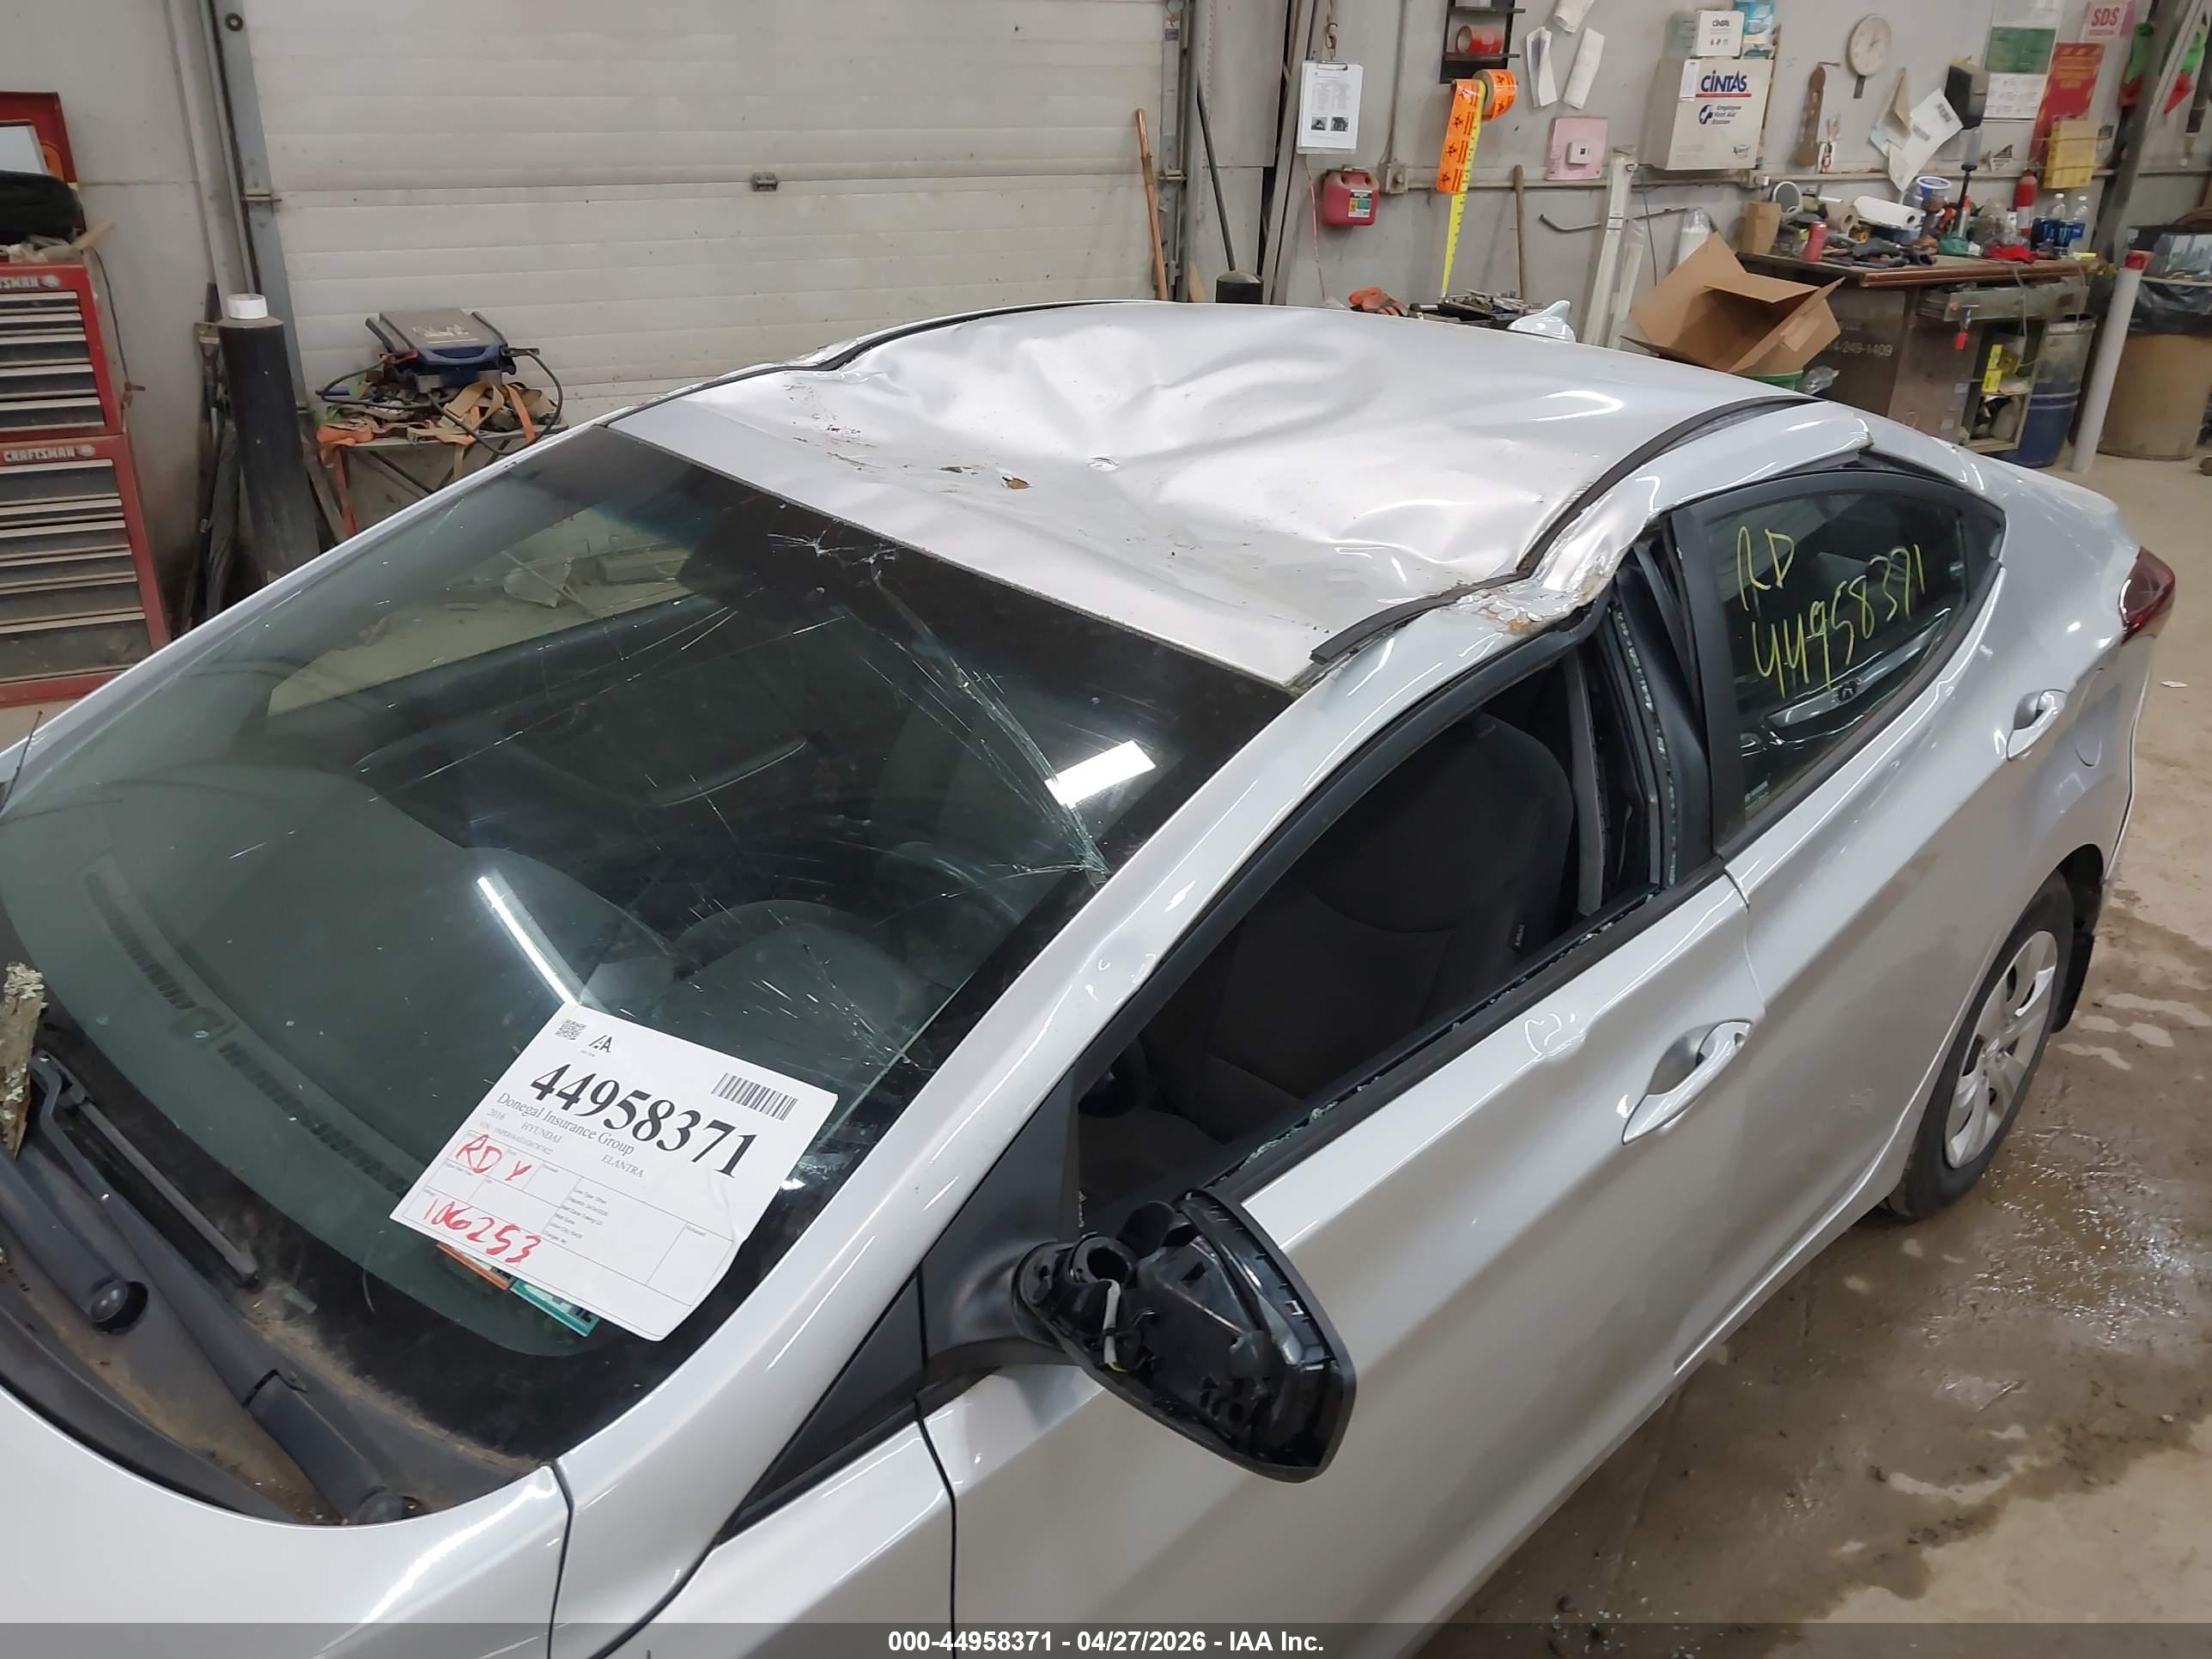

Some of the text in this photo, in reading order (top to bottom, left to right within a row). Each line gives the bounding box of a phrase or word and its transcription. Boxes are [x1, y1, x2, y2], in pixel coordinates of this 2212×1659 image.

[2091, 7, 2119, 27] SDS
[1700, 70, 1747, 93] CINTAS
[3, 446, 76, 462] CRAFTSMAN
[1752, 543, 1926, 699] 44958371
[496, 1091, 544, 1117] Donegal
[542, 1109, 598, 1140] Insurance
[598, 1132, 635, 1157] Group
[520, 1121, 563, 1144] HYUNDAI
[601, 1154, 645, 1178] ELANTRA
[530, 1063, 758, 1179] 44958371
